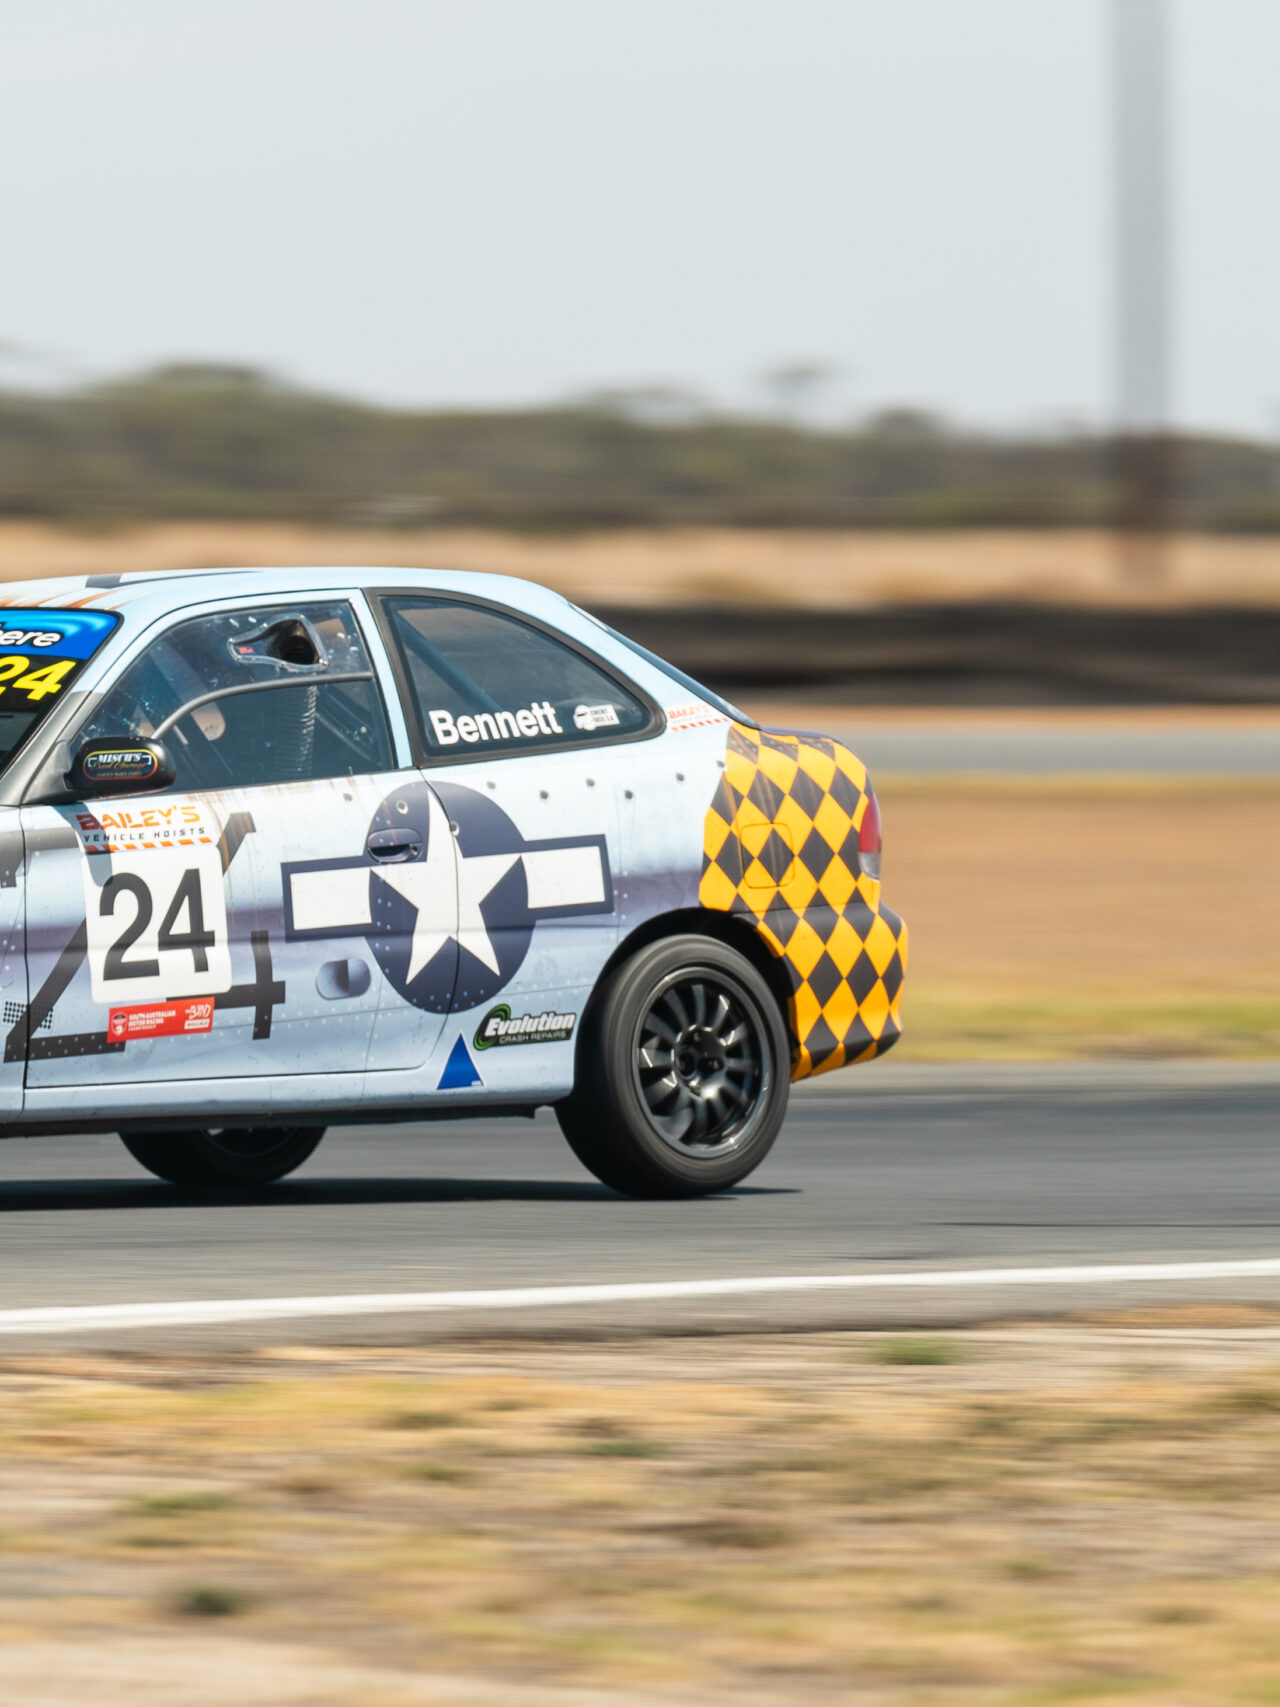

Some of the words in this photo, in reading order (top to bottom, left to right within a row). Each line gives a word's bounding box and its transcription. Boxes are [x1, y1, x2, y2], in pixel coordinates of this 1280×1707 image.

[428, 701, 563, 745] Bennett
[76, 805, 200, 831] BAILEY'S
[84, 832, 145, 843] VEHICLE
[154, 826, 205, 839] HOISTS
[99, 868, 215, 981] 24
[146, 1009, 176, 1019] AUSTRALIAN
[484, 1012, 576, 1037] Evolution
[500, 1033, 529, 1044] CRASH
[531, 1030, 566, 1040] REPAIRS
